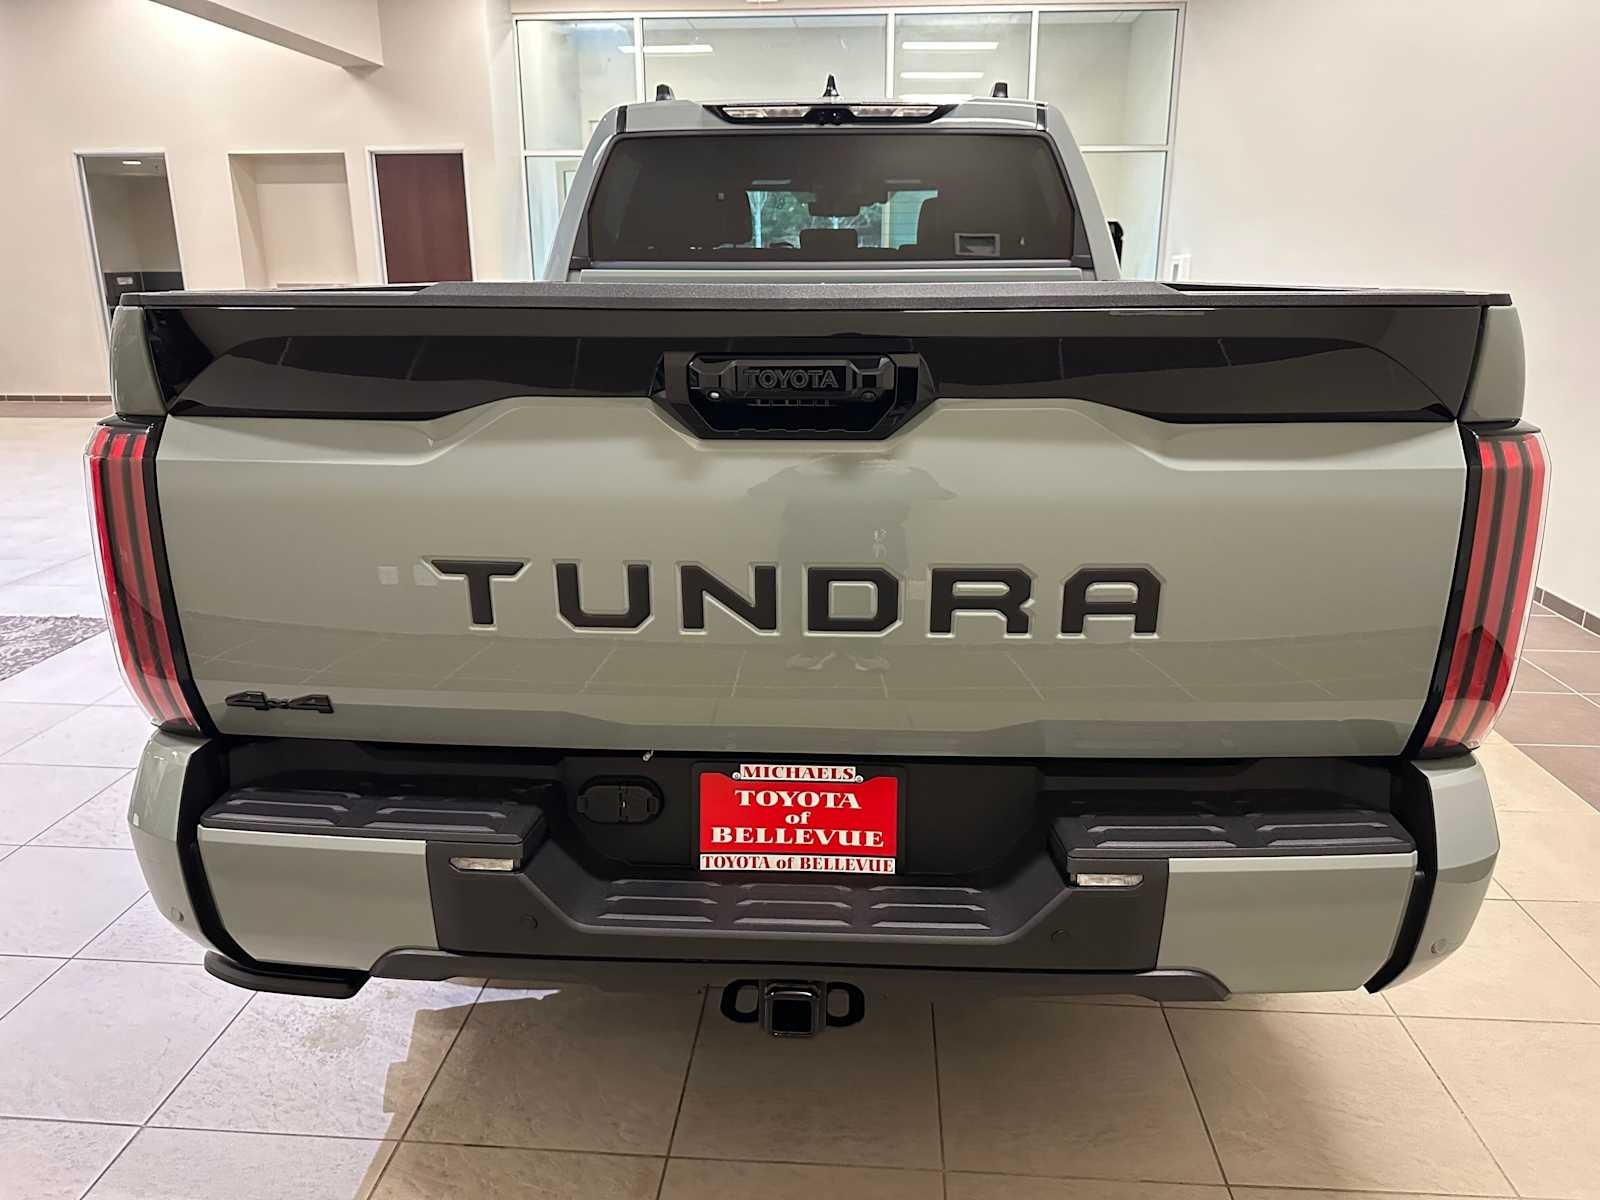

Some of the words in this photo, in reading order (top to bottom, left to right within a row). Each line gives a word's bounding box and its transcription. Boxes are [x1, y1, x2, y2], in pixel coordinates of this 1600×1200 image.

[743, 369, 840, 388] TOYOTA
[424, 558, 1165, 638] TUNDRA
[743, 766, 854, 780] MICHAELS
[734, 789, 862, 809] TOYOTA
[784, 811, 811, 825] of
[711, 826, 884, 848] BELLEVUE
[702, 855, 770, 870] TOYOTA
[776, 856, 795, 870] of
[800, 857, 894, 873] BELLEVUE
